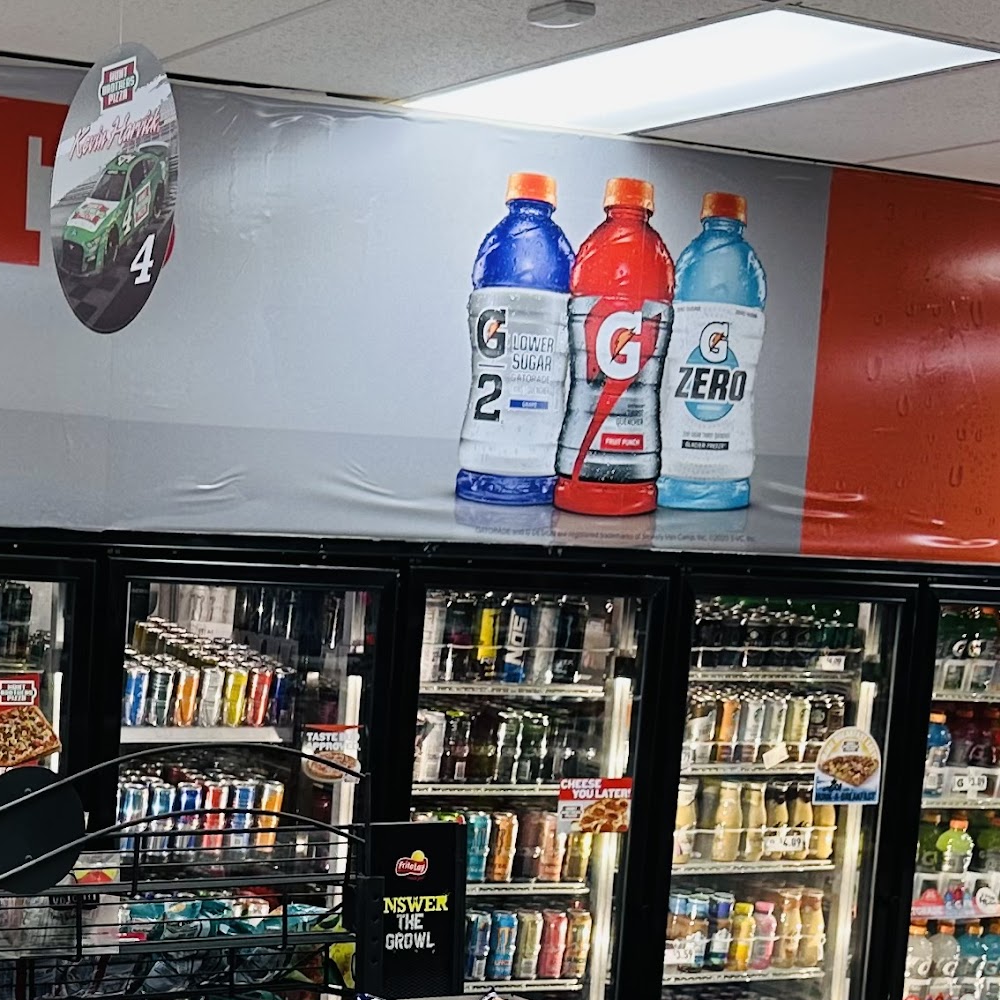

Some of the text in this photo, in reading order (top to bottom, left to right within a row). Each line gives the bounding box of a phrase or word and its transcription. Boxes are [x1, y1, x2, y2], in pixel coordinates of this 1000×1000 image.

[130, 233, 156, 285] 4
[476, 308, 507, 360] G
[512, 333, 554, 353] LOWER
[698, 321, 729, 363] G
[595, 310, 643, 381] G
[511, 354, 552, 372] SUGAR
[674, 366, 747, 402] ZERO
[473, 373, 503, 422] 2
[503, 613, 528, 664] NOS
[306, 732, 338, 742] TASTE
[560, 778, 602, 791] CHEESE
[572, 788, 632, 799] YOU LATER!
[383, 894, 448, 914] NSWER
[396, 913, 424, 931] THE
[385, 931, 435, 951] GROWL
